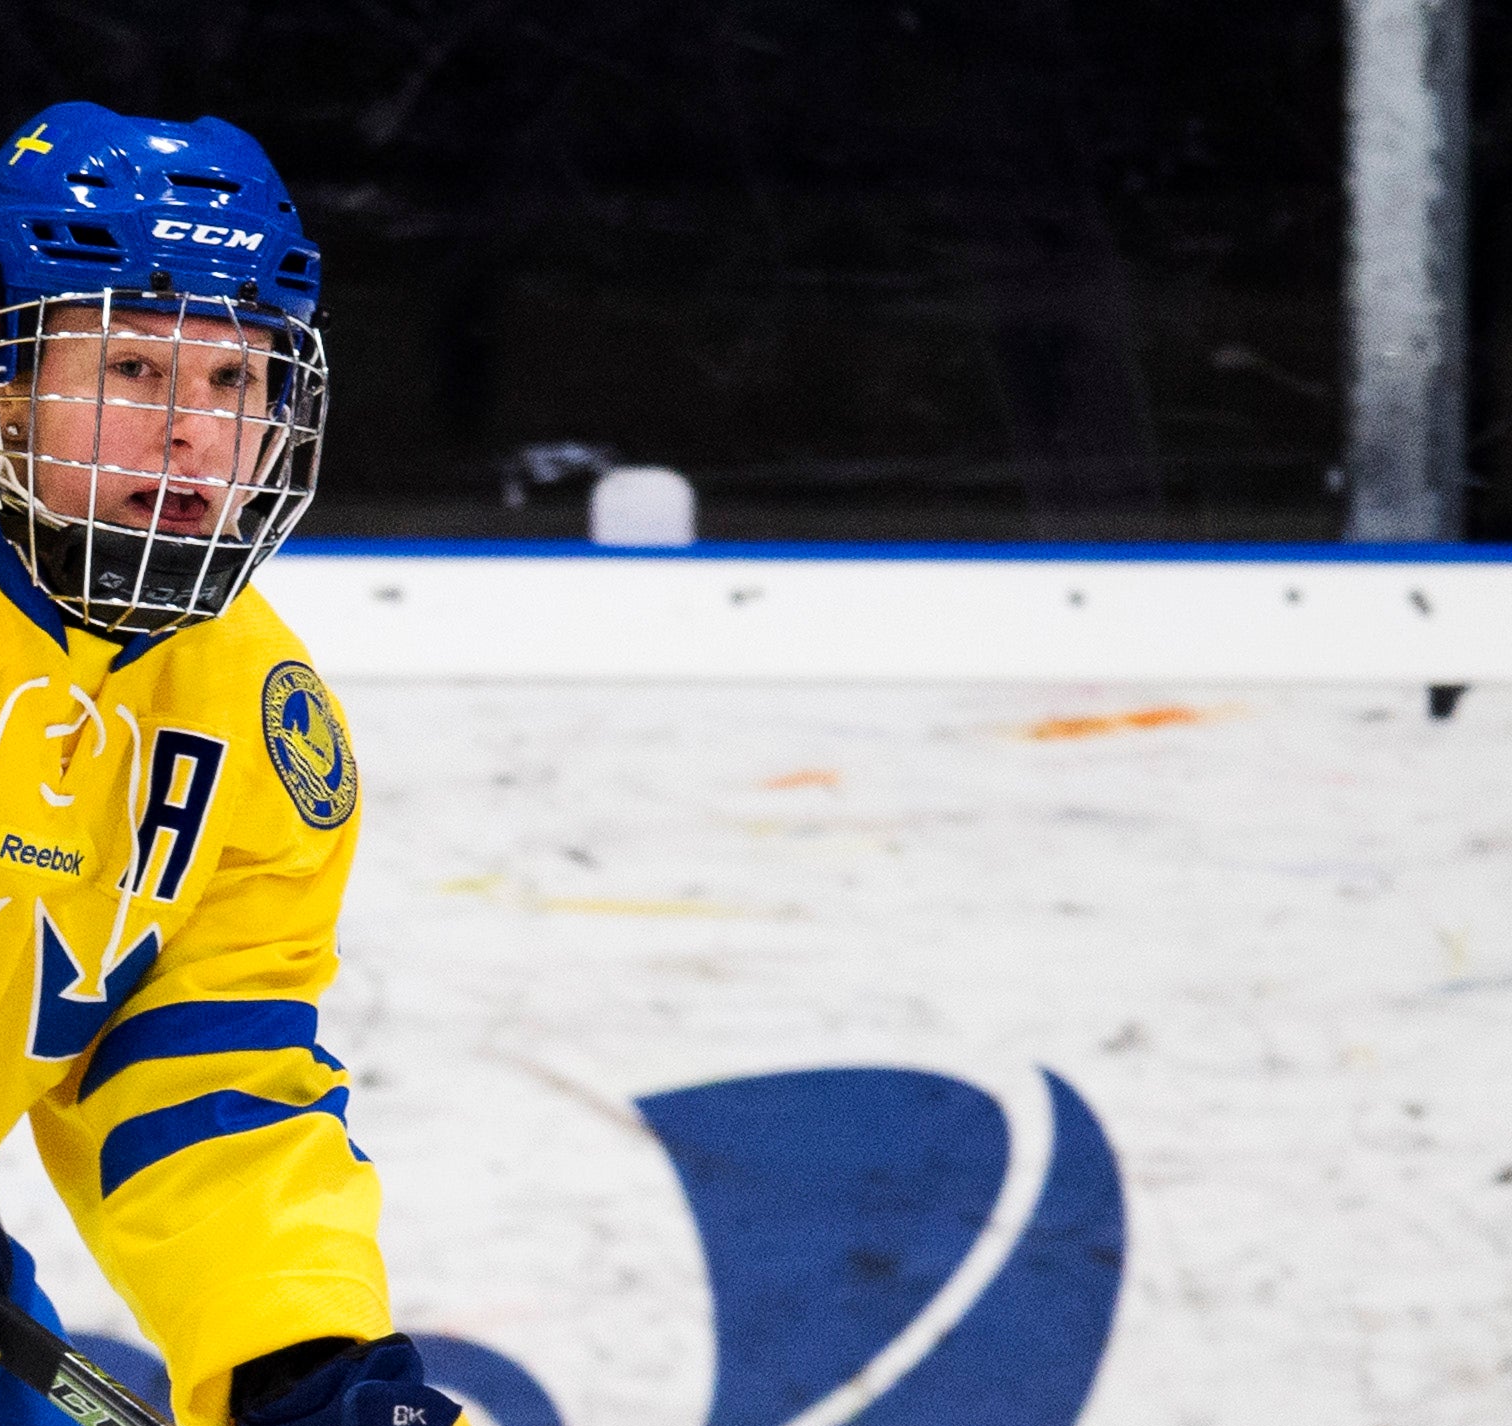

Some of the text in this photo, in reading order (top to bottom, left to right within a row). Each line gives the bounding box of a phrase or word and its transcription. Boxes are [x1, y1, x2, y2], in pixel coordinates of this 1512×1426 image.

[152, 219, 265, 251] CCM
[115, 727, 229, 904] A
[0, 833, 85, 876] Reebok
